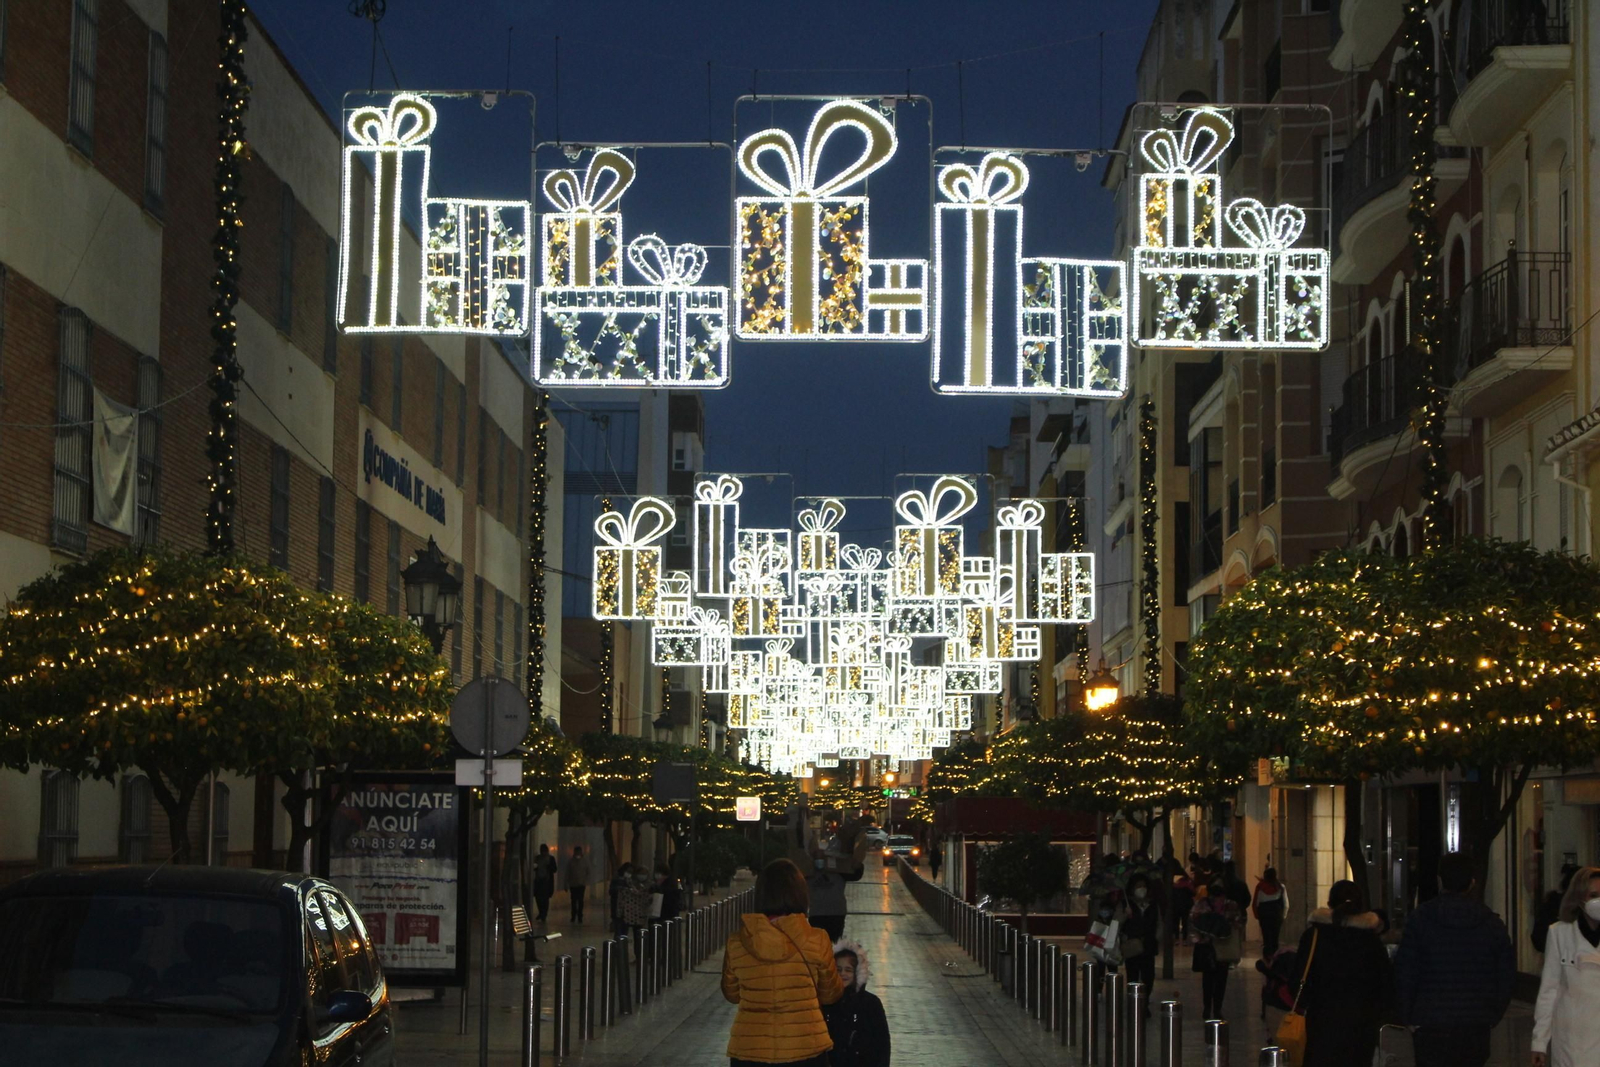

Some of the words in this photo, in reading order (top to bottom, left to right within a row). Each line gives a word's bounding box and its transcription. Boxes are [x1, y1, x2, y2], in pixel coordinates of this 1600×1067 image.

[414, 475, 424, 511] DE
[341, 787, 453, 809] ANÚNCIATE
[366, 811, 420, 833] AQUÍ
[351, 837, 366, 849] 91
[371, 838, 395, 850] 815
[399, 838, 416, 850] 42
[419, 838, 436, 850] 54
